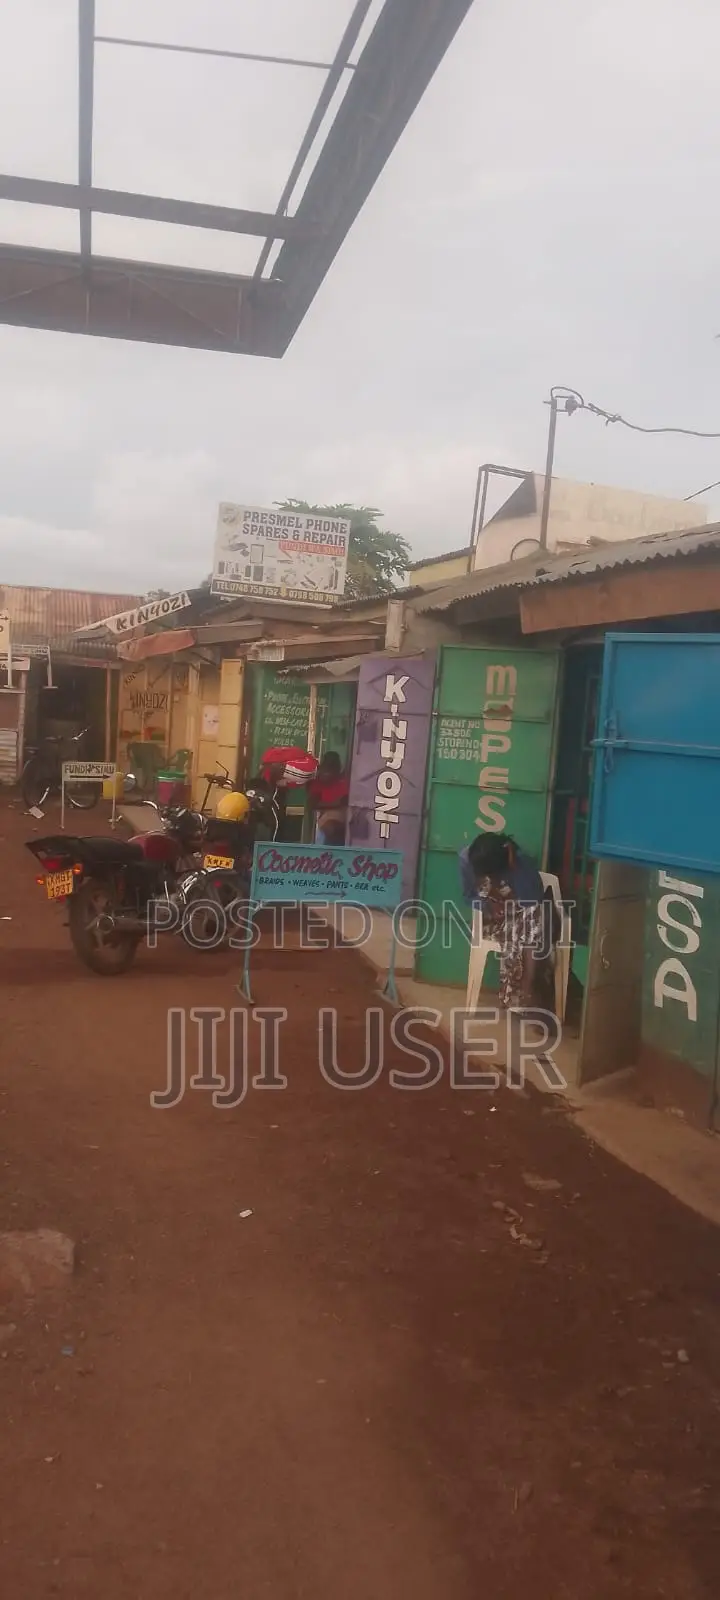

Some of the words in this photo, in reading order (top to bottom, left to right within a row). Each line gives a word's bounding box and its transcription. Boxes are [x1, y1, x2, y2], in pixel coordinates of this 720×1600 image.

[243, 510, 302, 529] PRESMEL
[306, 518, 347, 534] PHONE
[242, 523, 289, 540] SPARES
[292, 529, 300, 541] &
[303, 530, 346, 547] REPAIR
[115, 593, 187, 630] KINYOZI
[129, 691, 168, 712] KINYOZI
[258, 849, 344, 879] Cosmetic
[347, 855, 398, 884] Shop
[258, 876, 285, 886] BRAIDS
[292, 879, 321, 888] WEAVES
[326, 881, 348, 889] PANTS
